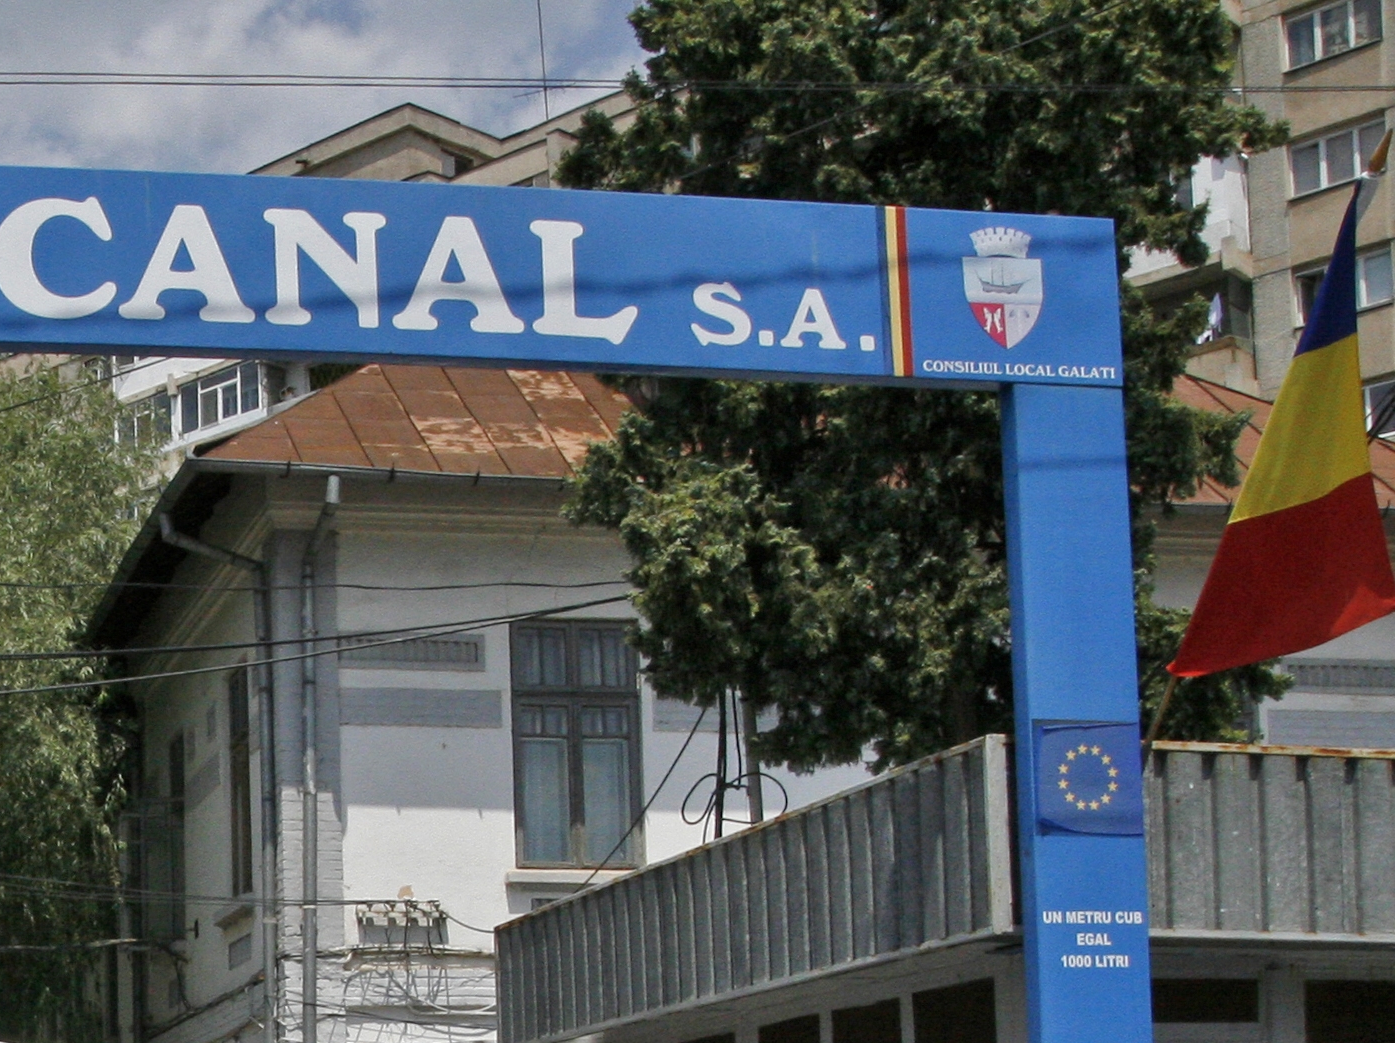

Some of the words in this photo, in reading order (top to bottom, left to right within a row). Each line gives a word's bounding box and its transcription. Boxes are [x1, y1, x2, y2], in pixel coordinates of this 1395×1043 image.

[691, 282, 875, 351] S.A.
[922, 359, 1003, 375] CONSILIUL
[1005, 363, 1055, 377] LOCAL
[1058, 365, 1116, 379] GALATI
[1042, 911, 1062, 924] UN
[1065, 911, 1112, 924] METRU
[1115, 911, 1143, 924] CUB
[1076, 933, 1112, 946] EGAL
[1061, 955, 1092, 967] 1000
[1095, 955, 1129, 967] LITRI
